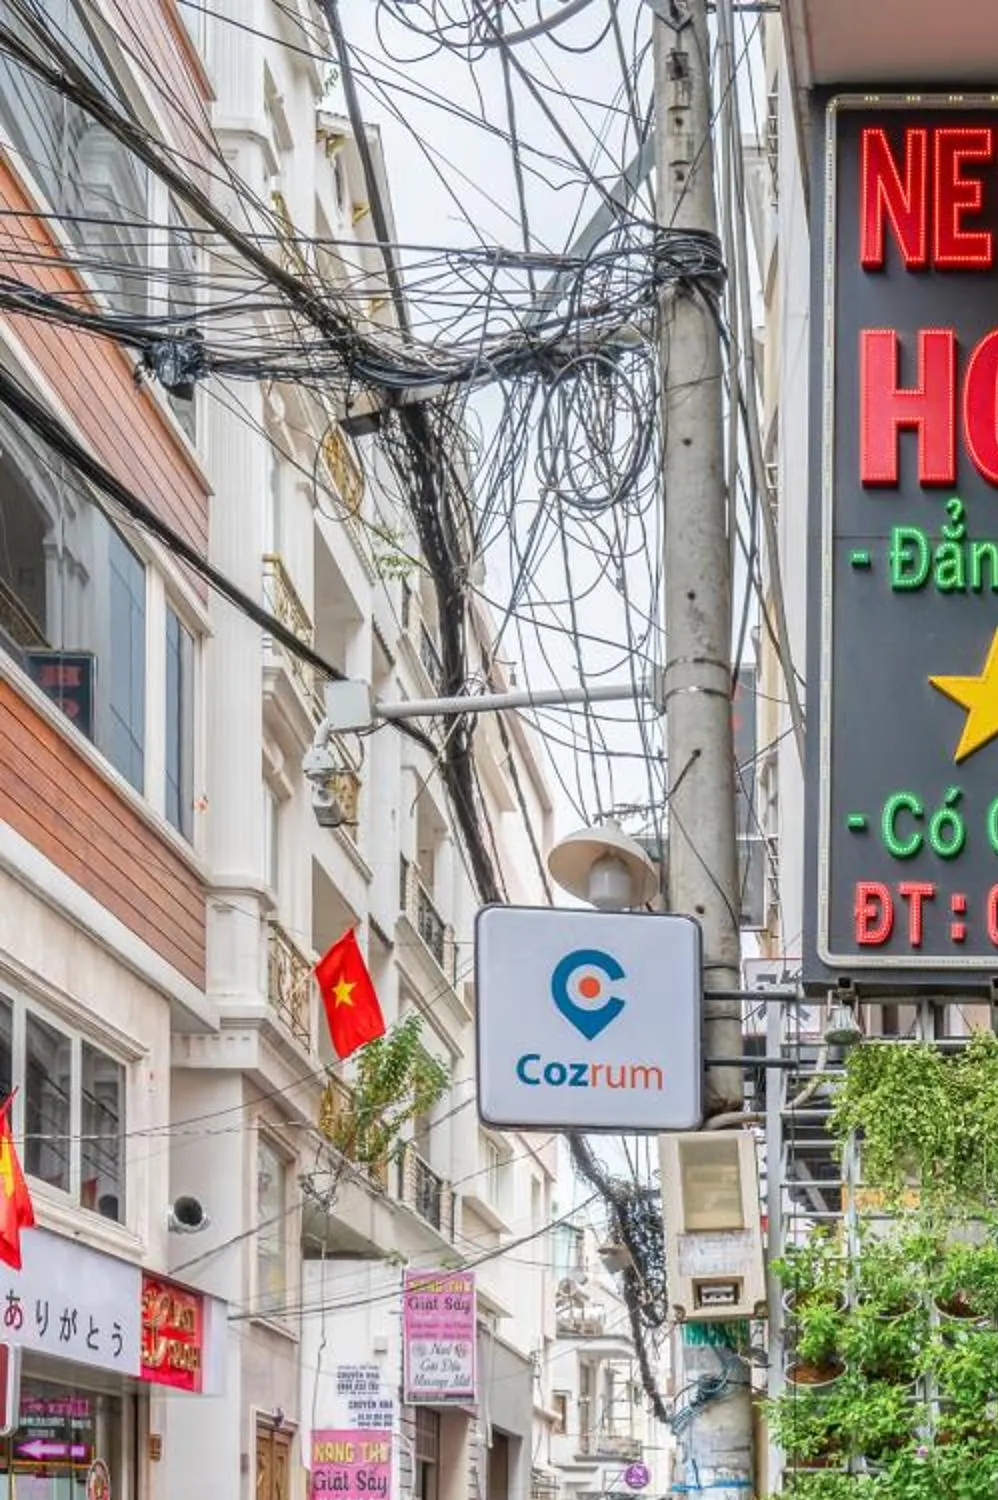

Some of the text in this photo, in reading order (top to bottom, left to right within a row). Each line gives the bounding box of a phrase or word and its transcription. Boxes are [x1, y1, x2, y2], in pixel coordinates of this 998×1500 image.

[881, 787, 966, 859] Có
[516, 1054, 663, 1091] Cozrum
[4, 1289, 124, 1357] ありがとう
